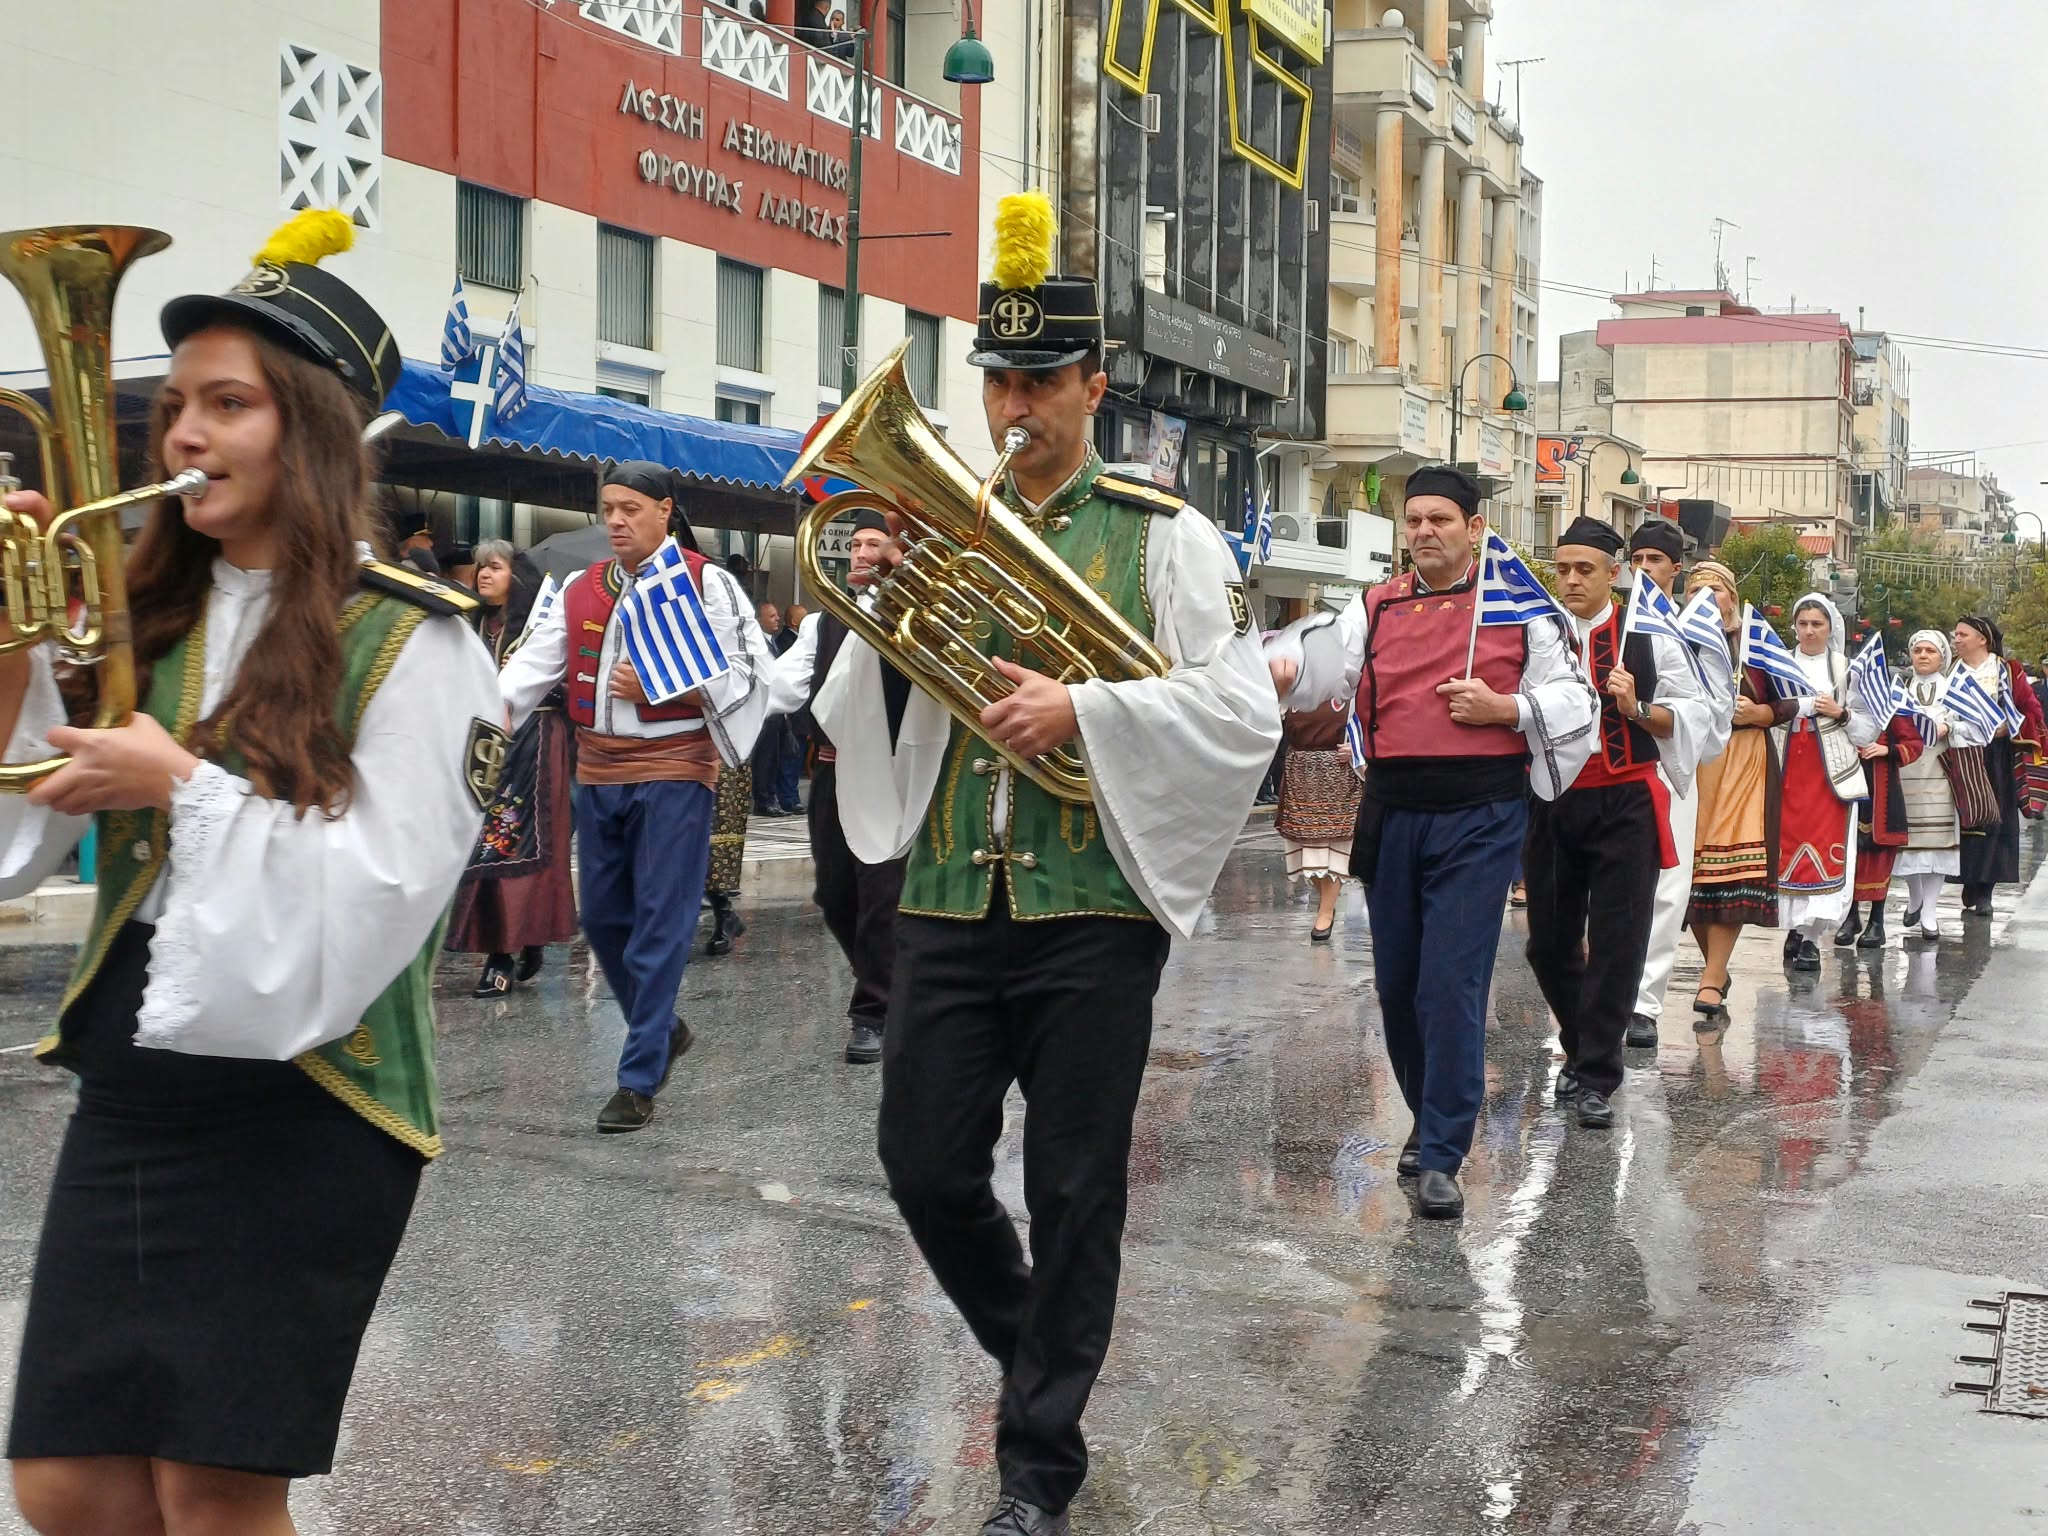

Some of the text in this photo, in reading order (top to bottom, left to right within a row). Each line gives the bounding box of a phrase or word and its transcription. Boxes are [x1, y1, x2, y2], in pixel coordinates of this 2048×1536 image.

[619, 79, 849, 192] ΛΕΣΧΗ ΑΞΙΩΜΑΤΙΚΩ
[638, 149, 845, 246] ΦΡΟΥΡΑΣ ΛΑΡΙΣΑΣ
